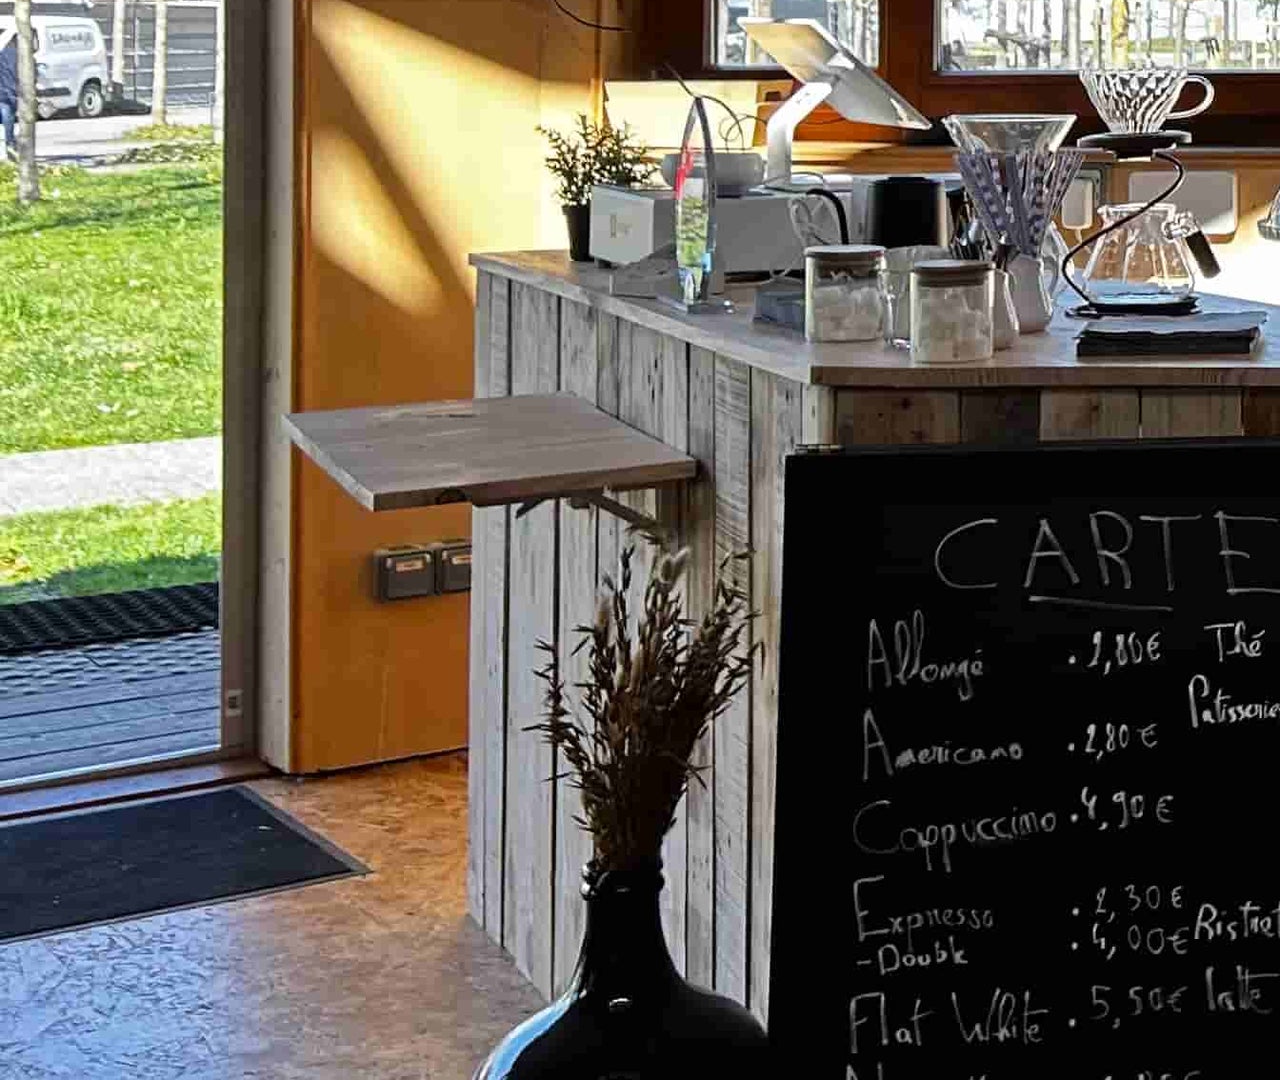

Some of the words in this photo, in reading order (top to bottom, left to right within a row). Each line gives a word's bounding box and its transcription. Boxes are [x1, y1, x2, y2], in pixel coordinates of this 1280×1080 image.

[867, 609, 984, 702] Allongé
[1204, 620, 1266, 663] Thé
[862, 708, 1023, 782] Americano
[853, 799, 1057, 873] Cappuccino
[853, 874, 994, 954] Expresso
[850, 991, 936, 1055] Flat
[952, 988, 1050, 1045] White
